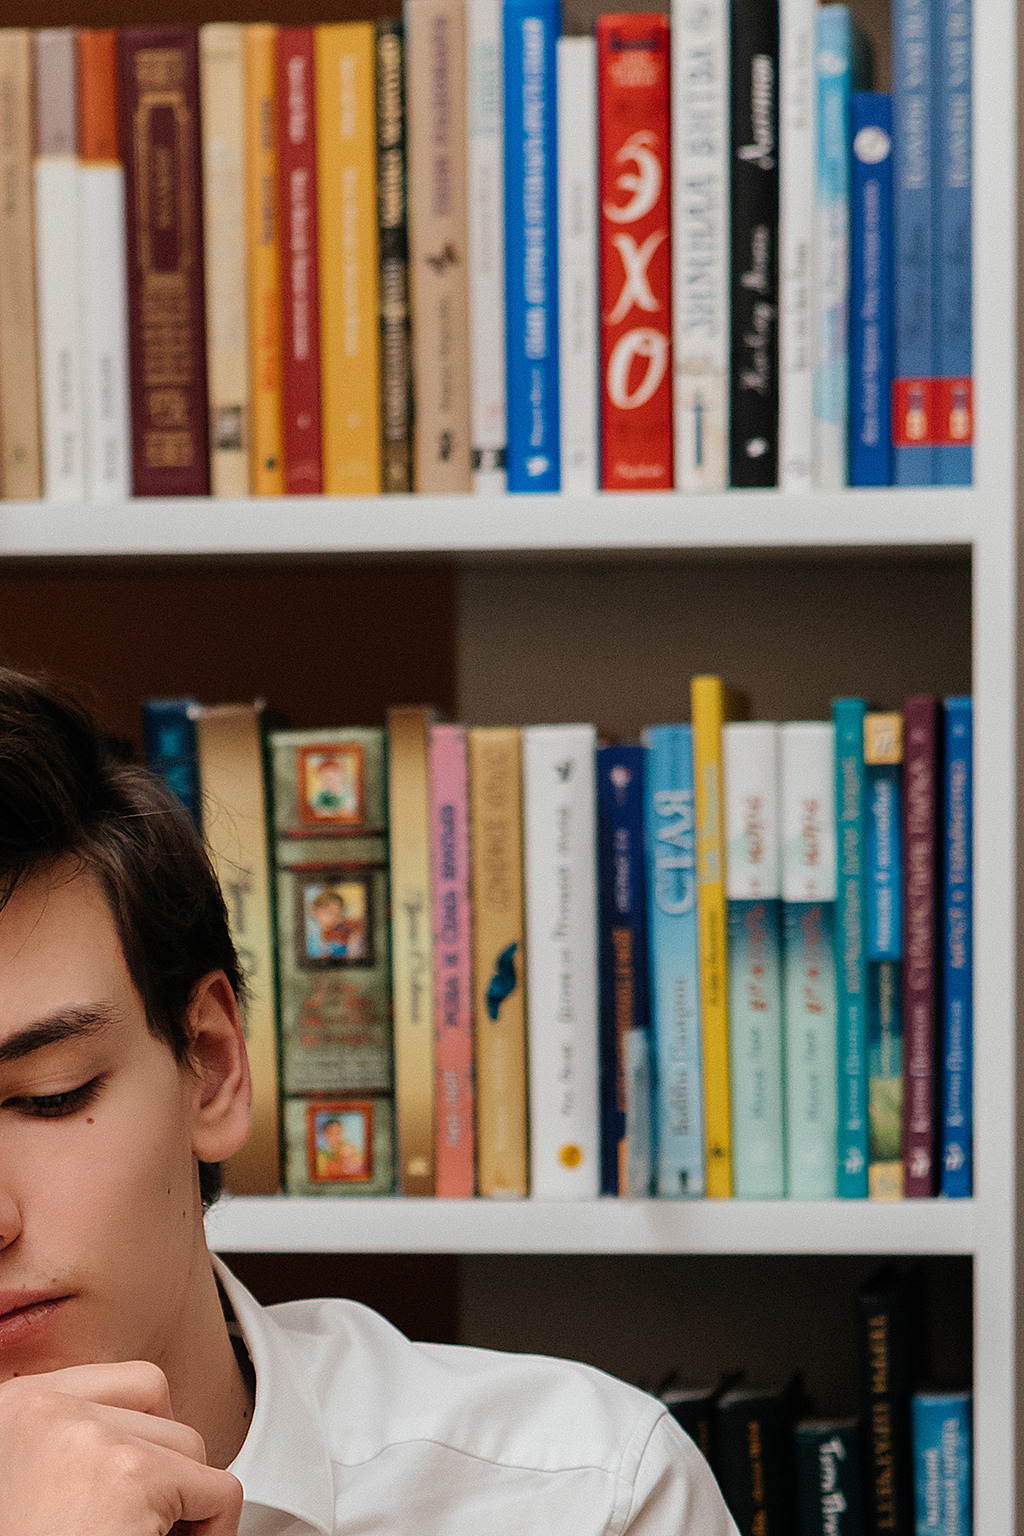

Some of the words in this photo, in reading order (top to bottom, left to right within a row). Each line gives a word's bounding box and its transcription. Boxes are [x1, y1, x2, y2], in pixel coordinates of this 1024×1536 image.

[604, 130, 668, 410] ЭХО
[684, 174, 717, 338] ЗИМНЯЯ
[654, 789, 694, 917] СТАЯ
[868, 1315, 890, 1394] ТЕРРИ
[872, 1402, 897, 1529] ПРАТЧЕТТ
